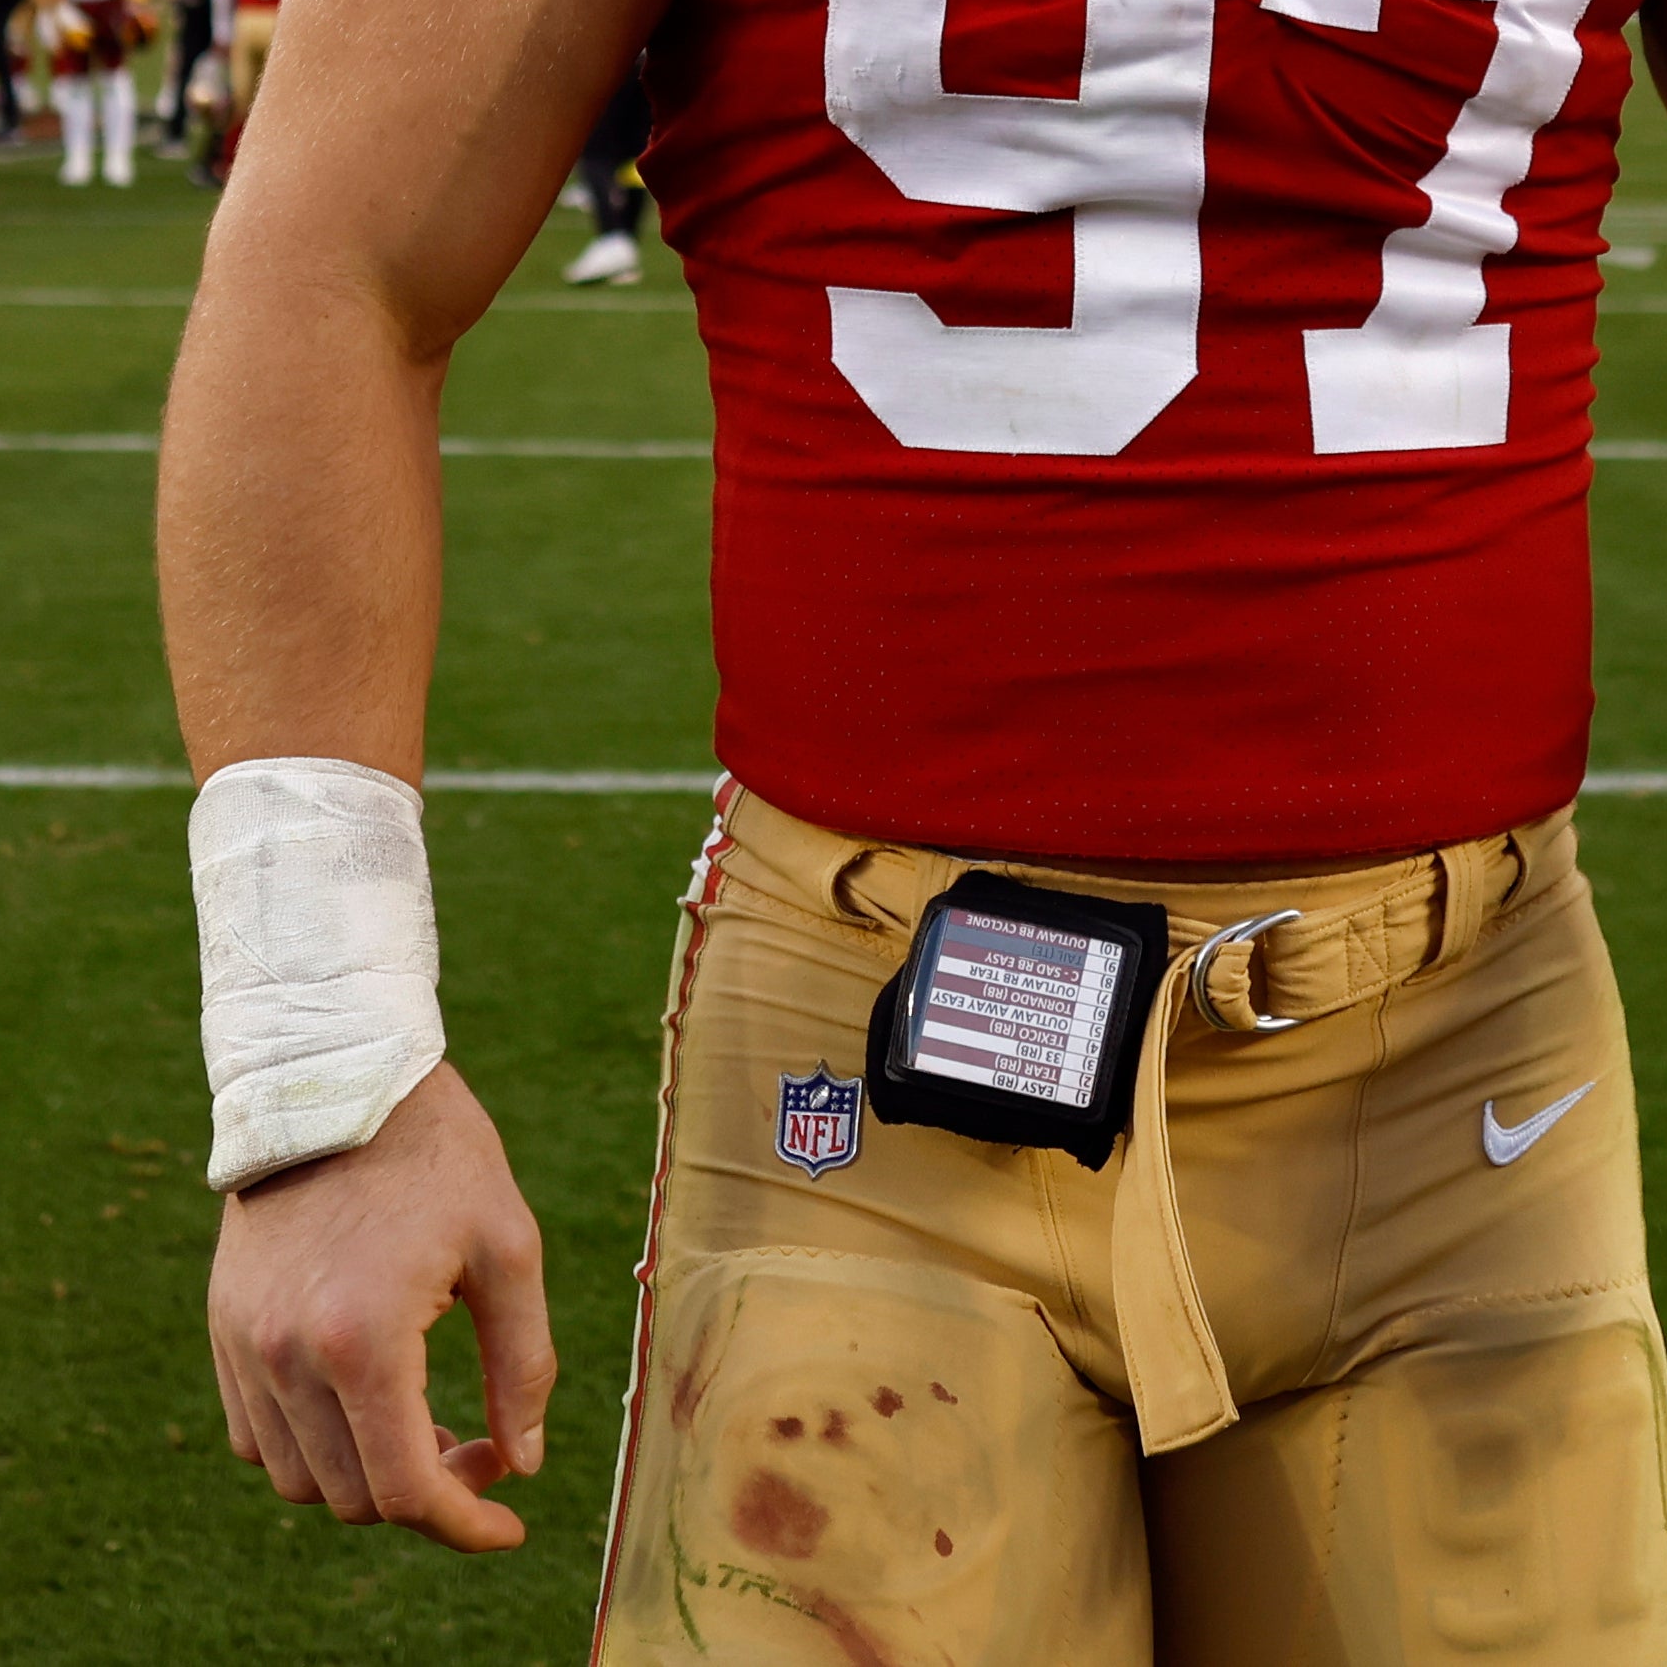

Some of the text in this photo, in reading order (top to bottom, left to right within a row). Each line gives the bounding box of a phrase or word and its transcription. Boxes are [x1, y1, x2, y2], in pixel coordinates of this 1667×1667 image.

[965, 914, 1120, 956] 10) OUTLAW RB CYCLONE
[985, 952, 1015, 967] EASY
[1017, 959, 1033, 972] RB
[1032, 943, 1117, 973] 9) TAIL (TE)
[1036, 965, 1061, 978] SAD
[969, 965, 1110, 1005] 7) OUTLAW RB TEAR
[1071, 971, 1080, 982] C
[1100, 976, 1113, 989] 8)
[933, 991, 1103, 1038] 5) OUTLAW AWAY EASY
[983, 984, 1105, 1021] 6) TORNADO (RB)
[990, 1019, 1099, 1054] 4) TEXICO (RB)
[995, 1054, 1092, 1087] 2) TEAR (RB)
[1016, 1042, 1096, 1071] 3) 33 (RB)
[992, 1072, 1089, 1105] 1) EASY (RB)
[787, 1113, 846, 1159] NFL
